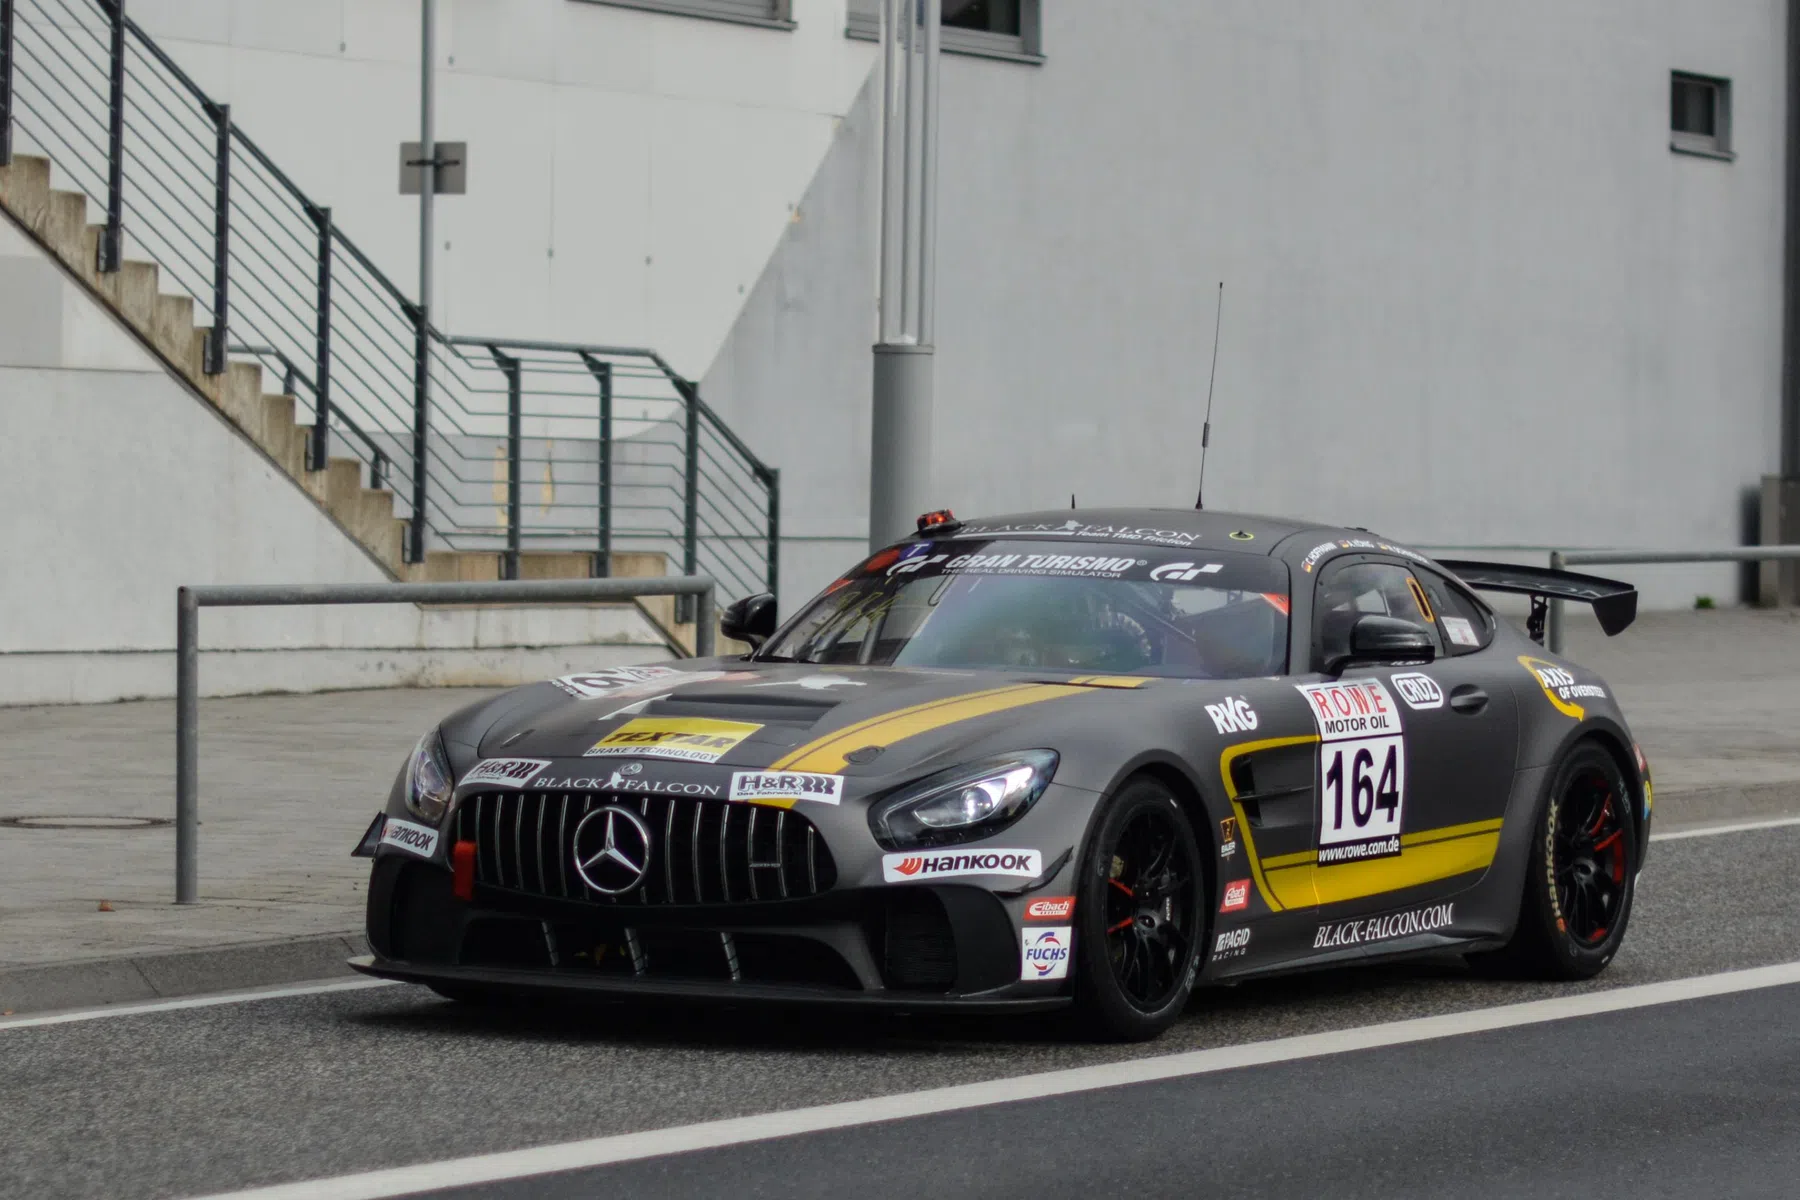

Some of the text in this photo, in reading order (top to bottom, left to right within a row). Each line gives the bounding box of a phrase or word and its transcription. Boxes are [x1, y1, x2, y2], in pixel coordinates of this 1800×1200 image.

[961, 523, 1202, 541] BLACK FALCON
[1076, 530, 1192, 547] Team TMD Friction
[945, 554, 1021, 568] GRAN
[1018, 554, 1136, 572] TURISMO
[1047, 569, 1121, 578] SIMULATOR
[1536, 667, 1574, 688] AXIS
[1397, 678, 1439, 702] CRUZ
[1558, 686, 1570, 699] OF
[1312, 685, 1387, 718] ROWE
[1204, 696, 1258, 734] RKG
[1325, 715, 1389, 734] MOTOR OIL
[604, 731, 737, 749] TEXTAR
[586, 746, 719, 762] BRAKE TECHNOLOGY
[533, 777, 721, 796] BLACK FALCON
[740, 775, 799, 791] H&R
[1326, 745, 1399, 830] 164
[1318, 837, 1399, 863] www.rowe.com.de
[1029, 901, 1069, 916] Eibach
[1313, 903, 1454, 948] BLACK-FALCON.COM
[1223, 928, 1250, 950] PAGID
[1026, 948, 1067, 961] FUCHS
[1212, 947, 1246, 962] RACING
